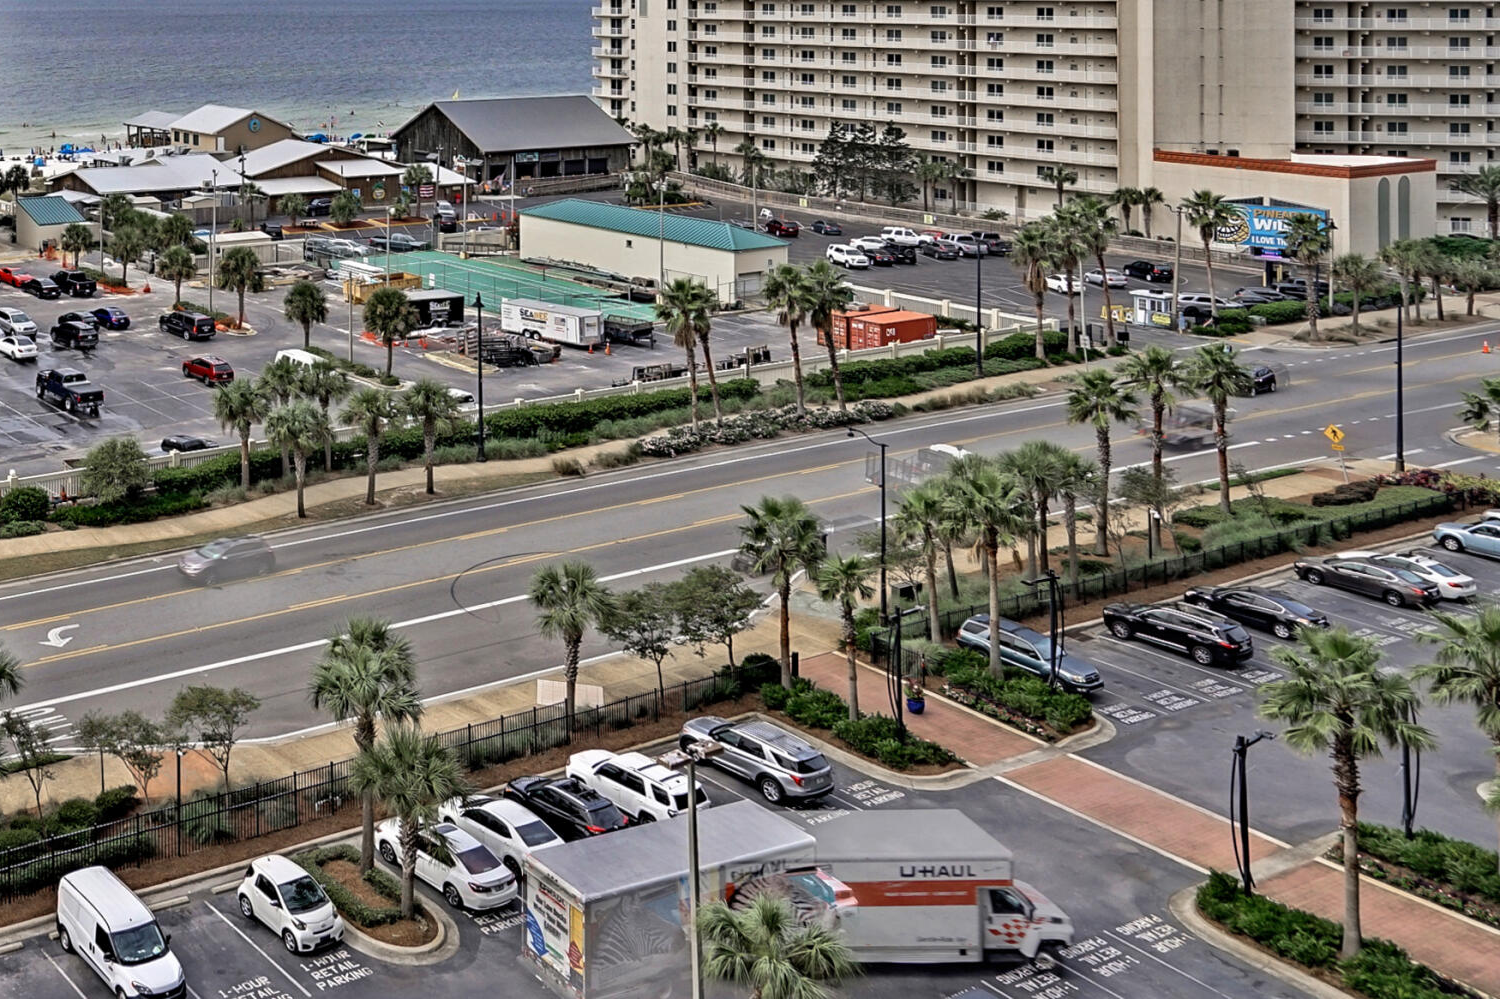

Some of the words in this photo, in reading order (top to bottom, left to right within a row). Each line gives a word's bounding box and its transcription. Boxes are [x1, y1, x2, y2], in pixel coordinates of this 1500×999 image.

[900, 865, 977, 878] U-HAUL
[311, 960, 361, 981] RETAIL
[316, 966, 374, 992] PARKING
[218, 975, 272, 998] 1-HOUR
